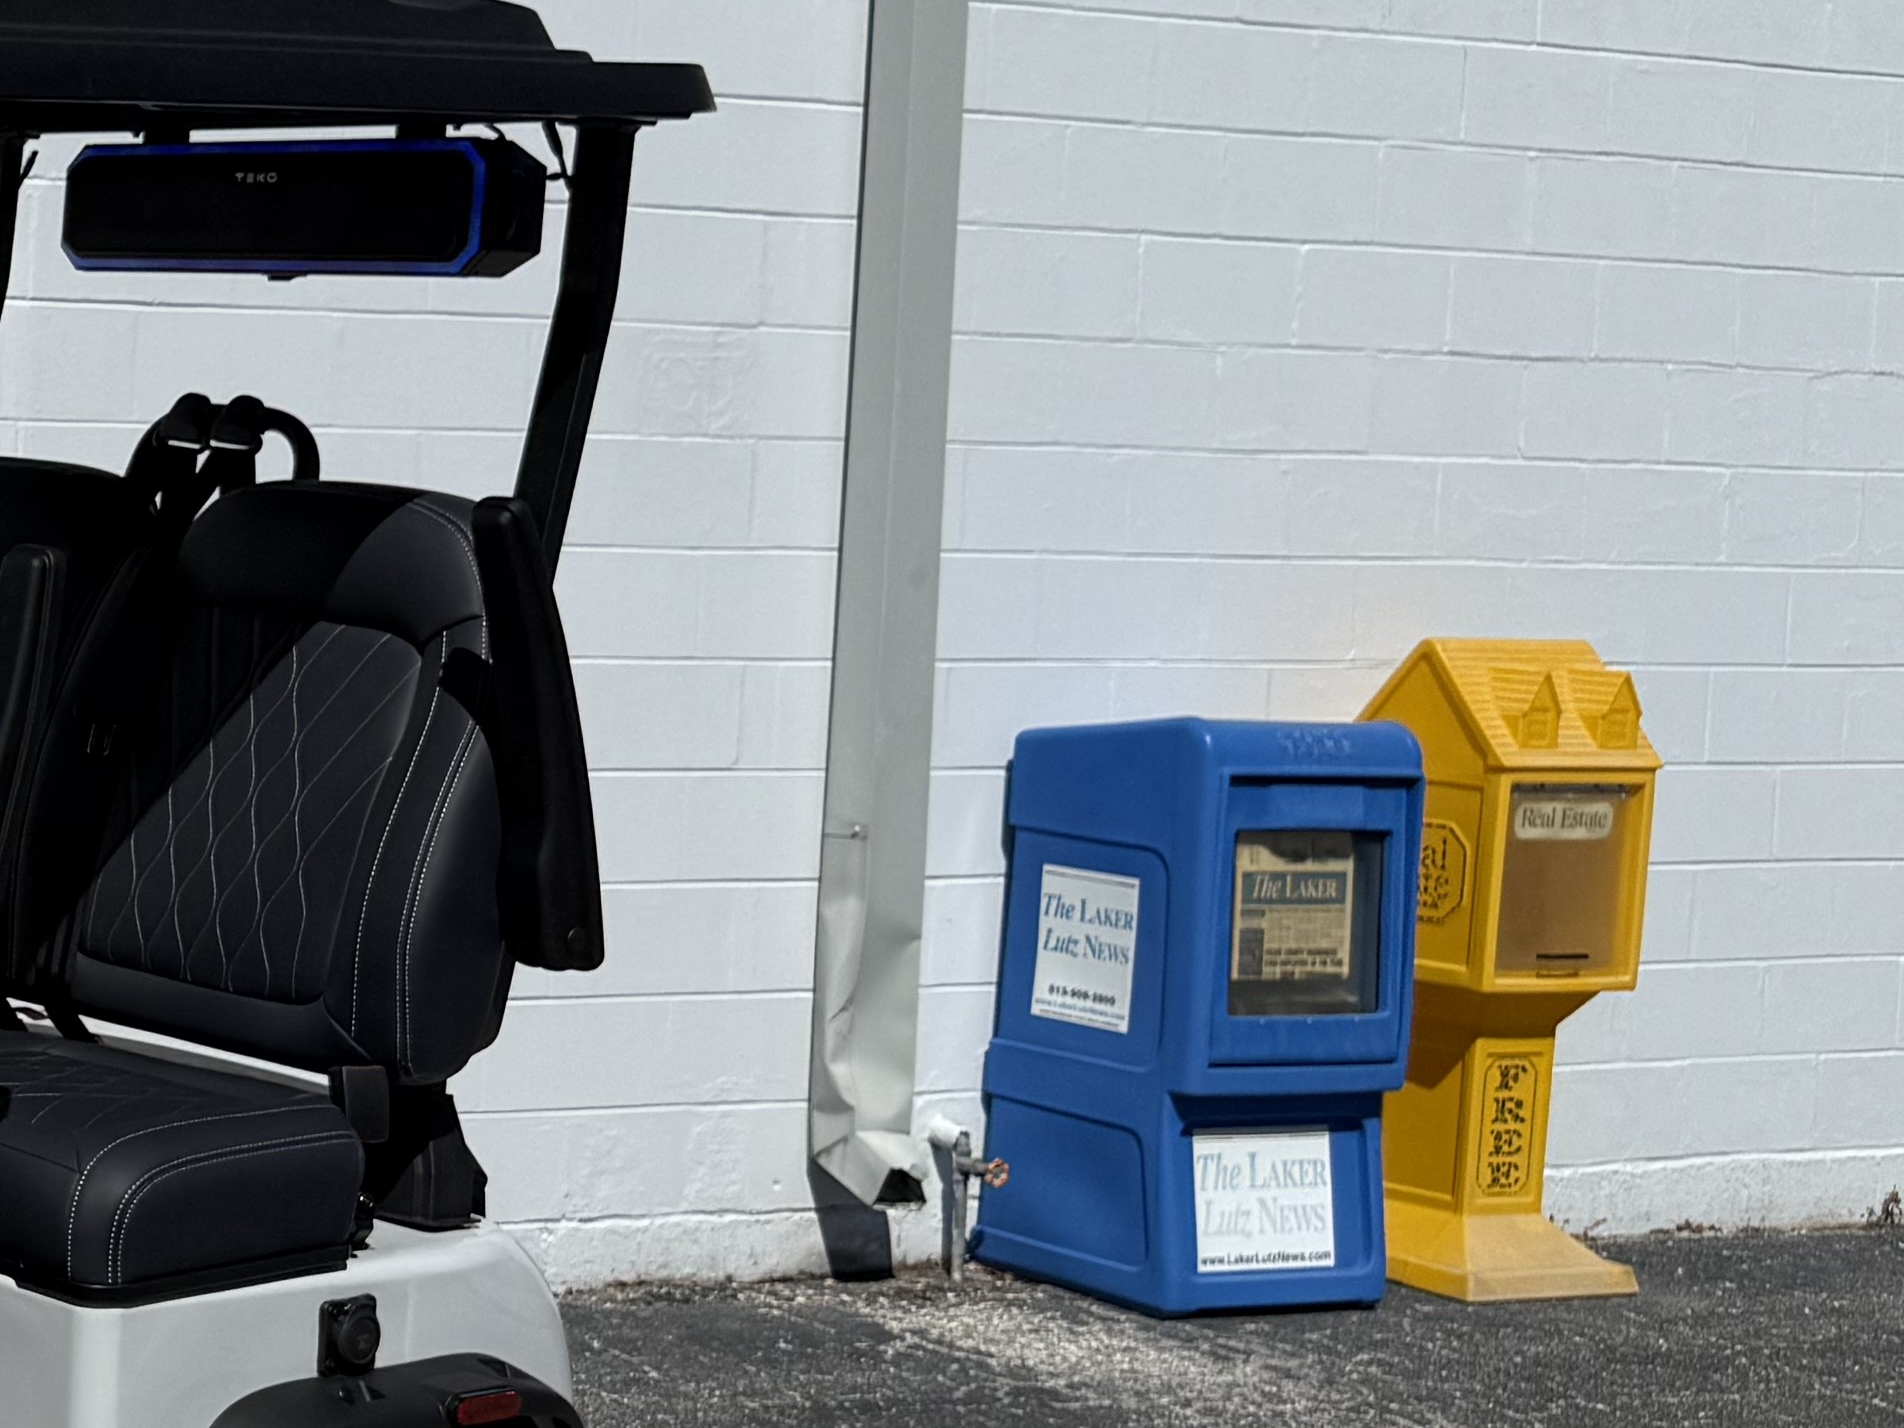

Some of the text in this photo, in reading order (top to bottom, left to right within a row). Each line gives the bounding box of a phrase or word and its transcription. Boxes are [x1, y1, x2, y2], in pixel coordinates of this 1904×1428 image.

[1520, 805, 1609, 832] Real Estate
[1252, 874, 1338, 900] The LAKER
[1043, 891, 1135, 932] The LAKER
[1042, 927, 1130, 965] Lutz NEWS
[1486, 1063, 1529, 1189] FREE
[1196, 1150, 1328, 1193] The LAKER
[1201, 1195, 1327, 1239] Lutz NEWS
